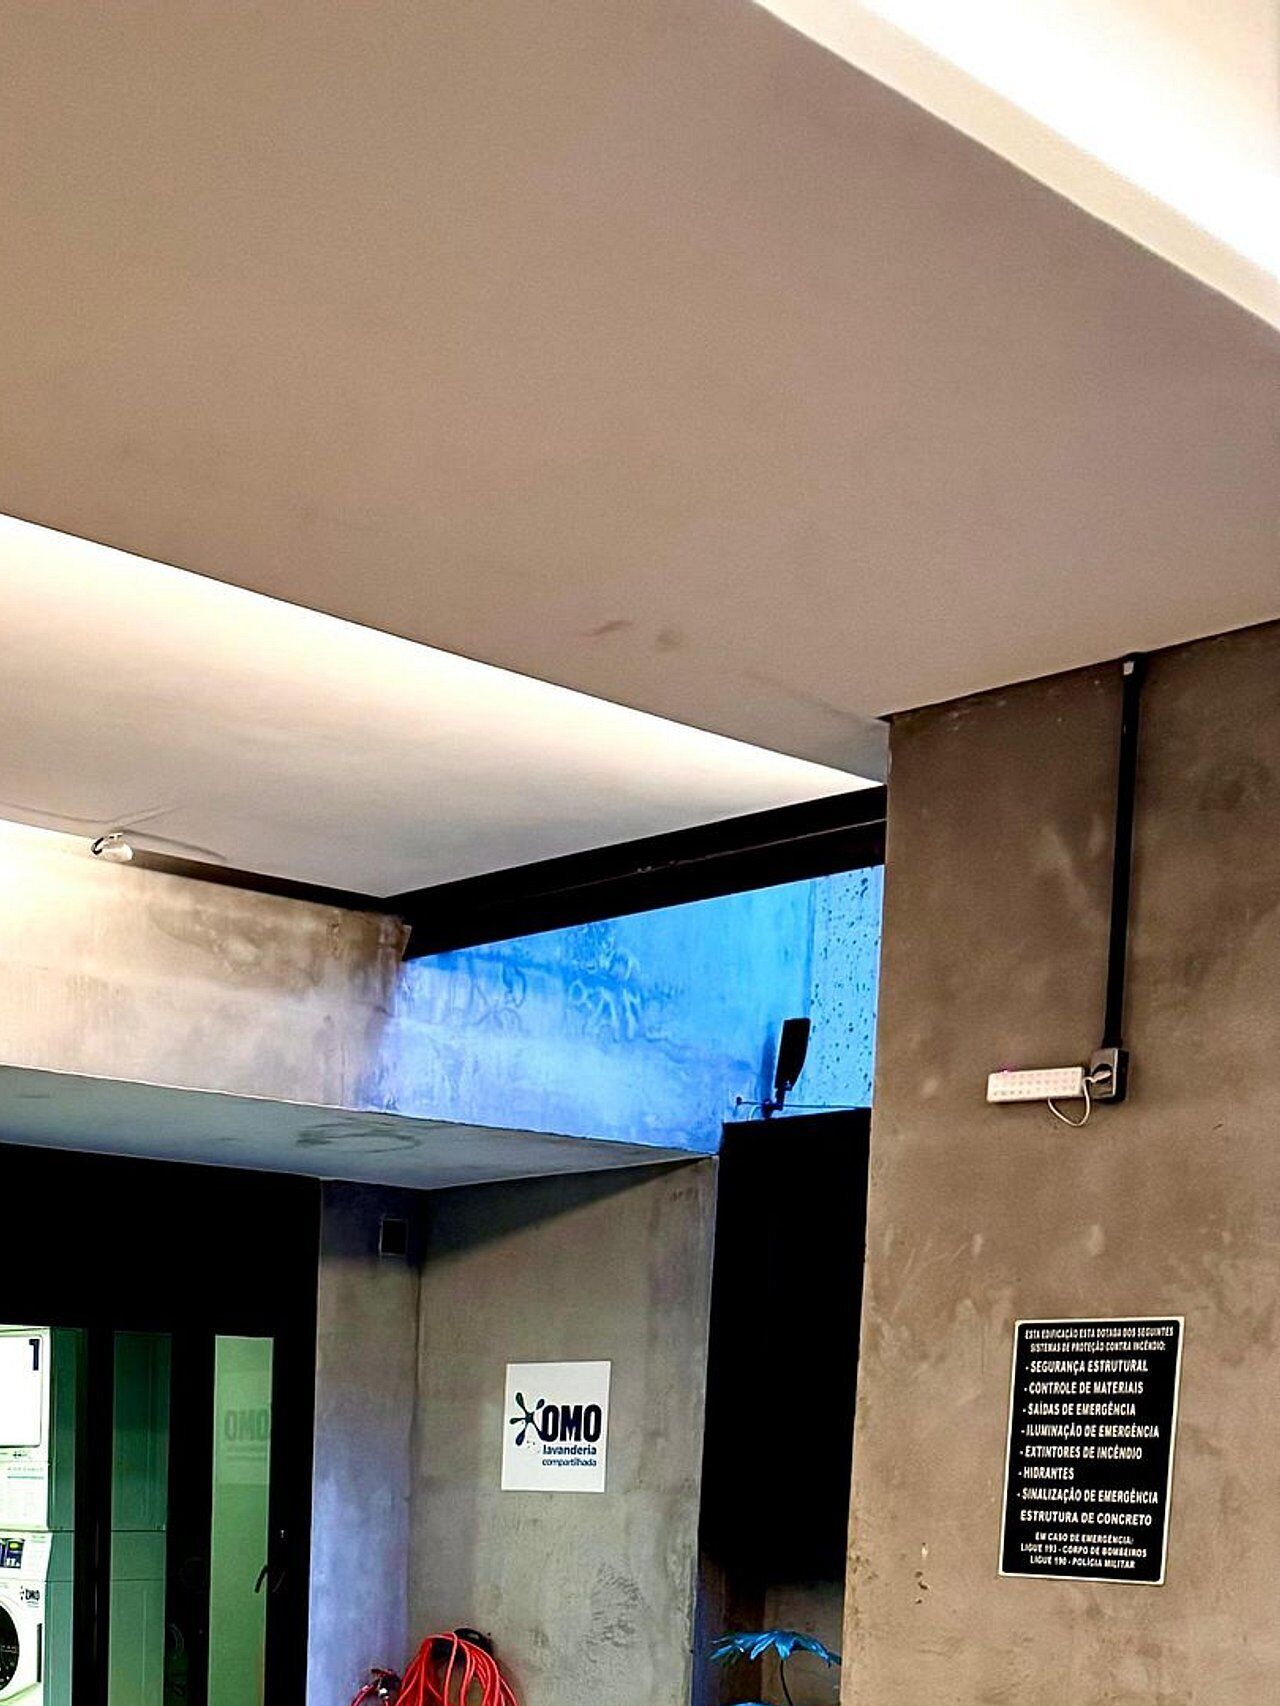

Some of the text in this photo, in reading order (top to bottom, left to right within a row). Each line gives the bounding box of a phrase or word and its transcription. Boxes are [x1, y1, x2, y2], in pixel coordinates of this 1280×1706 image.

[28, 1338, 41, 1371] 1
[1030, 1360, 1085, 1375] SEGURANÇA
[1087, 1359, 1148, 1372] ESTRUTURAL
[1028, 1381, 1077, 1394] CONTROLE
[1079, 1381, 1091, 1394] DE
[1093, 1381, 1144, 1394] MATERIAIS
[1027, 1401, 1060, 1416] SAÍDAS
[1062, 1403, 1074, 1415] DE
[1076, 1401, 1136, 1416] EMERGÊNCIA
[540, 1404, 602, 1443] OMO
[1026, 1422, 1082, 1440] ILUMINAÇÃO
[1084, 1424, 1096, 1438] DE
[1098, 1422, 1160, 1438] EMERGÊNCIA
[542, 1444, 597, 1455] lavanderia
[1025, 1445, 1081, 1459] EXTINTORES
[1082, 1445, 1095, 1458] DE
[1096, 1444, 1143, 1460] INCÊNDIO
[542, 1458, 597, 1467] compartilhada
[1023, 1466, 1074, 1480] HIDRANTES
[1022, 1486, 1082, 1504] SINALIZAÇÃO
[1083, 1489, 1096, 1502] DE
[1098, 1487, 1158, 1504] EMERGÊNCIA
[1020, 1509, 1152, 1526] ESTRUTURA DE CONCRETO
[1069, 1533, 1080, 1542] DE
[1020, 1542, 1043, 1553] LIGUE
[1090, 1545, 1100, 1556] DE
[1030, 1554, 1052, 1566] LIGUE
